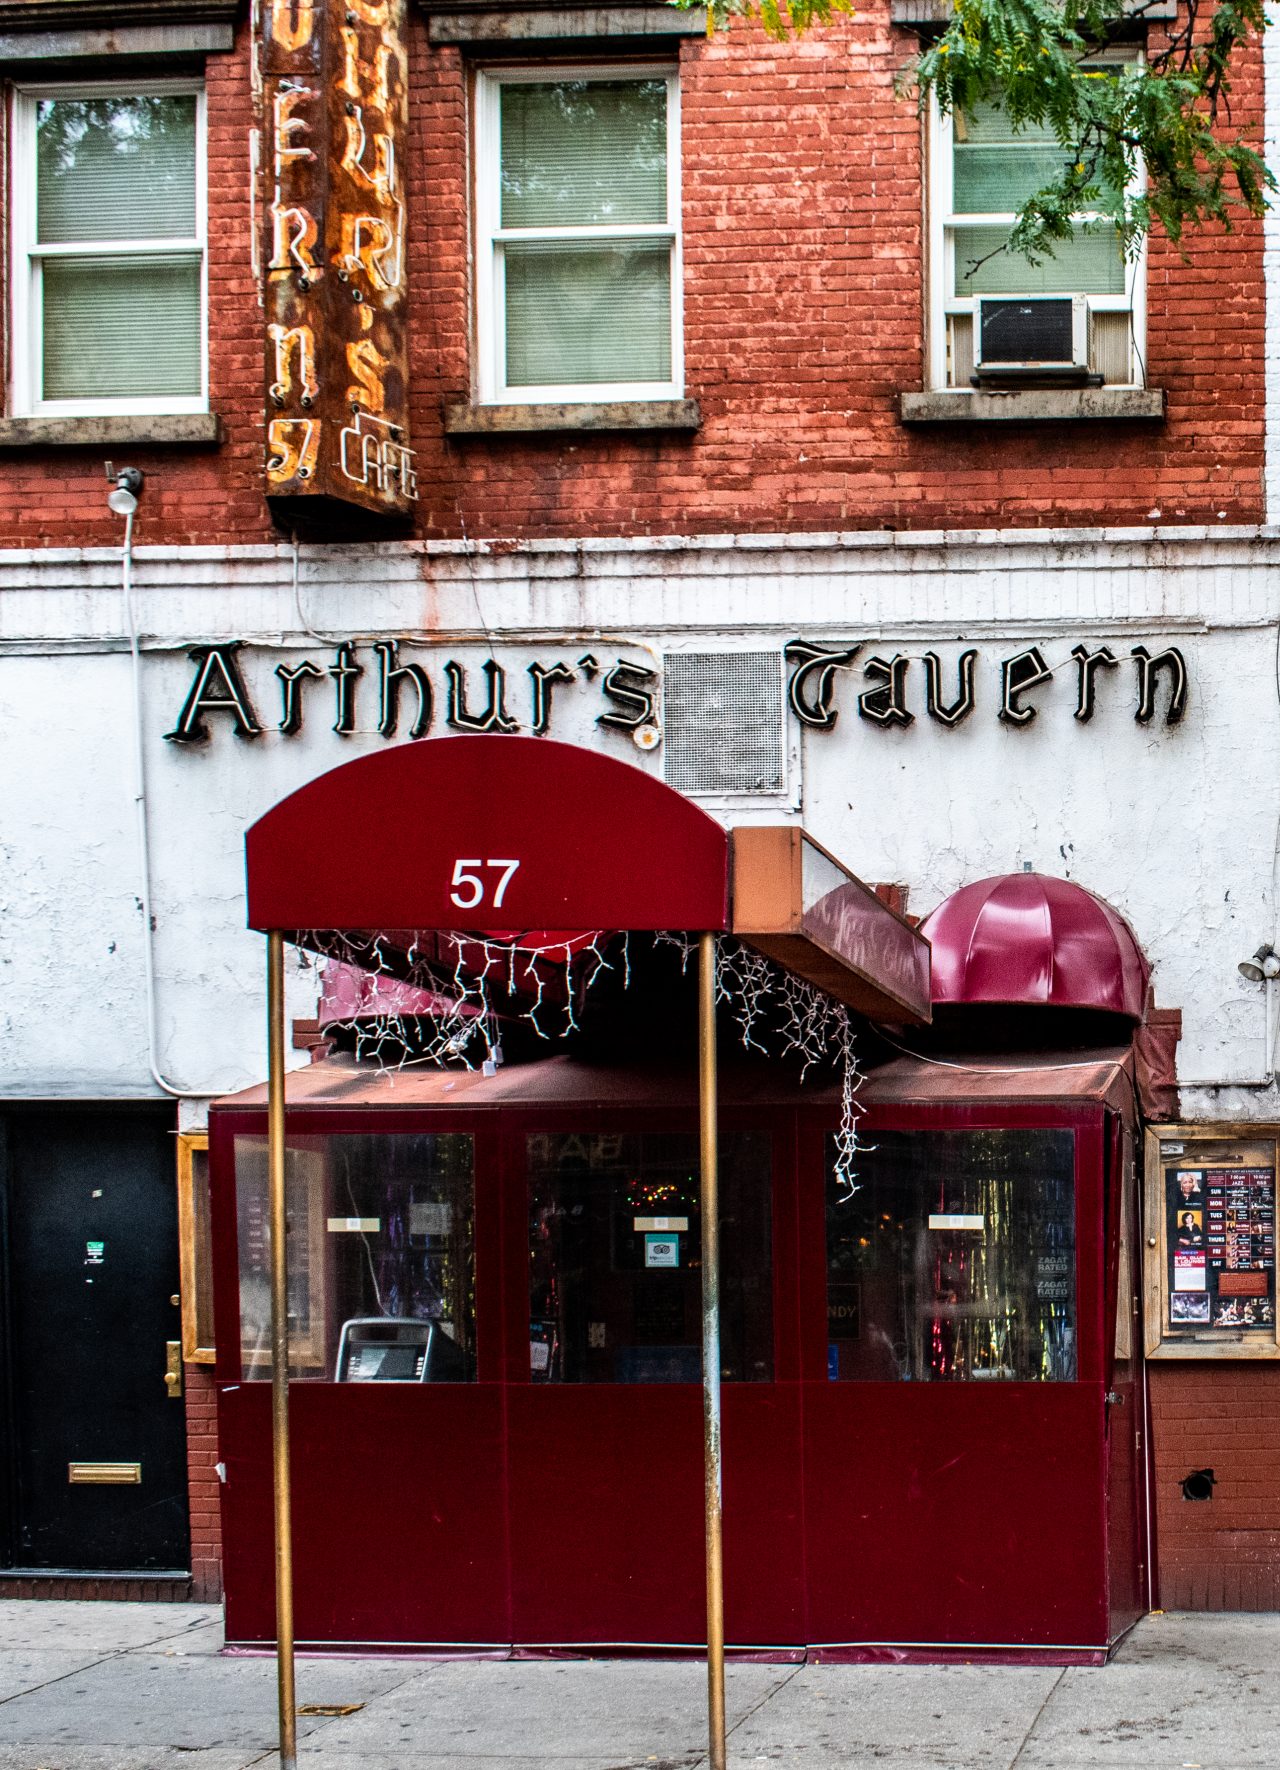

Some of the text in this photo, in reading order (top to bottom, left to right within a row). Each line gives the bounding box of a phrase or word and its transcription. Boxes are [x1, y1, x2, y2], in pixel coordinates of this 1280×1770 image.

[267, 418, 321, 483] 57
[163, 639, 1188, 740] Arthur's Tavern
[451, 859, 520, 909] 57
